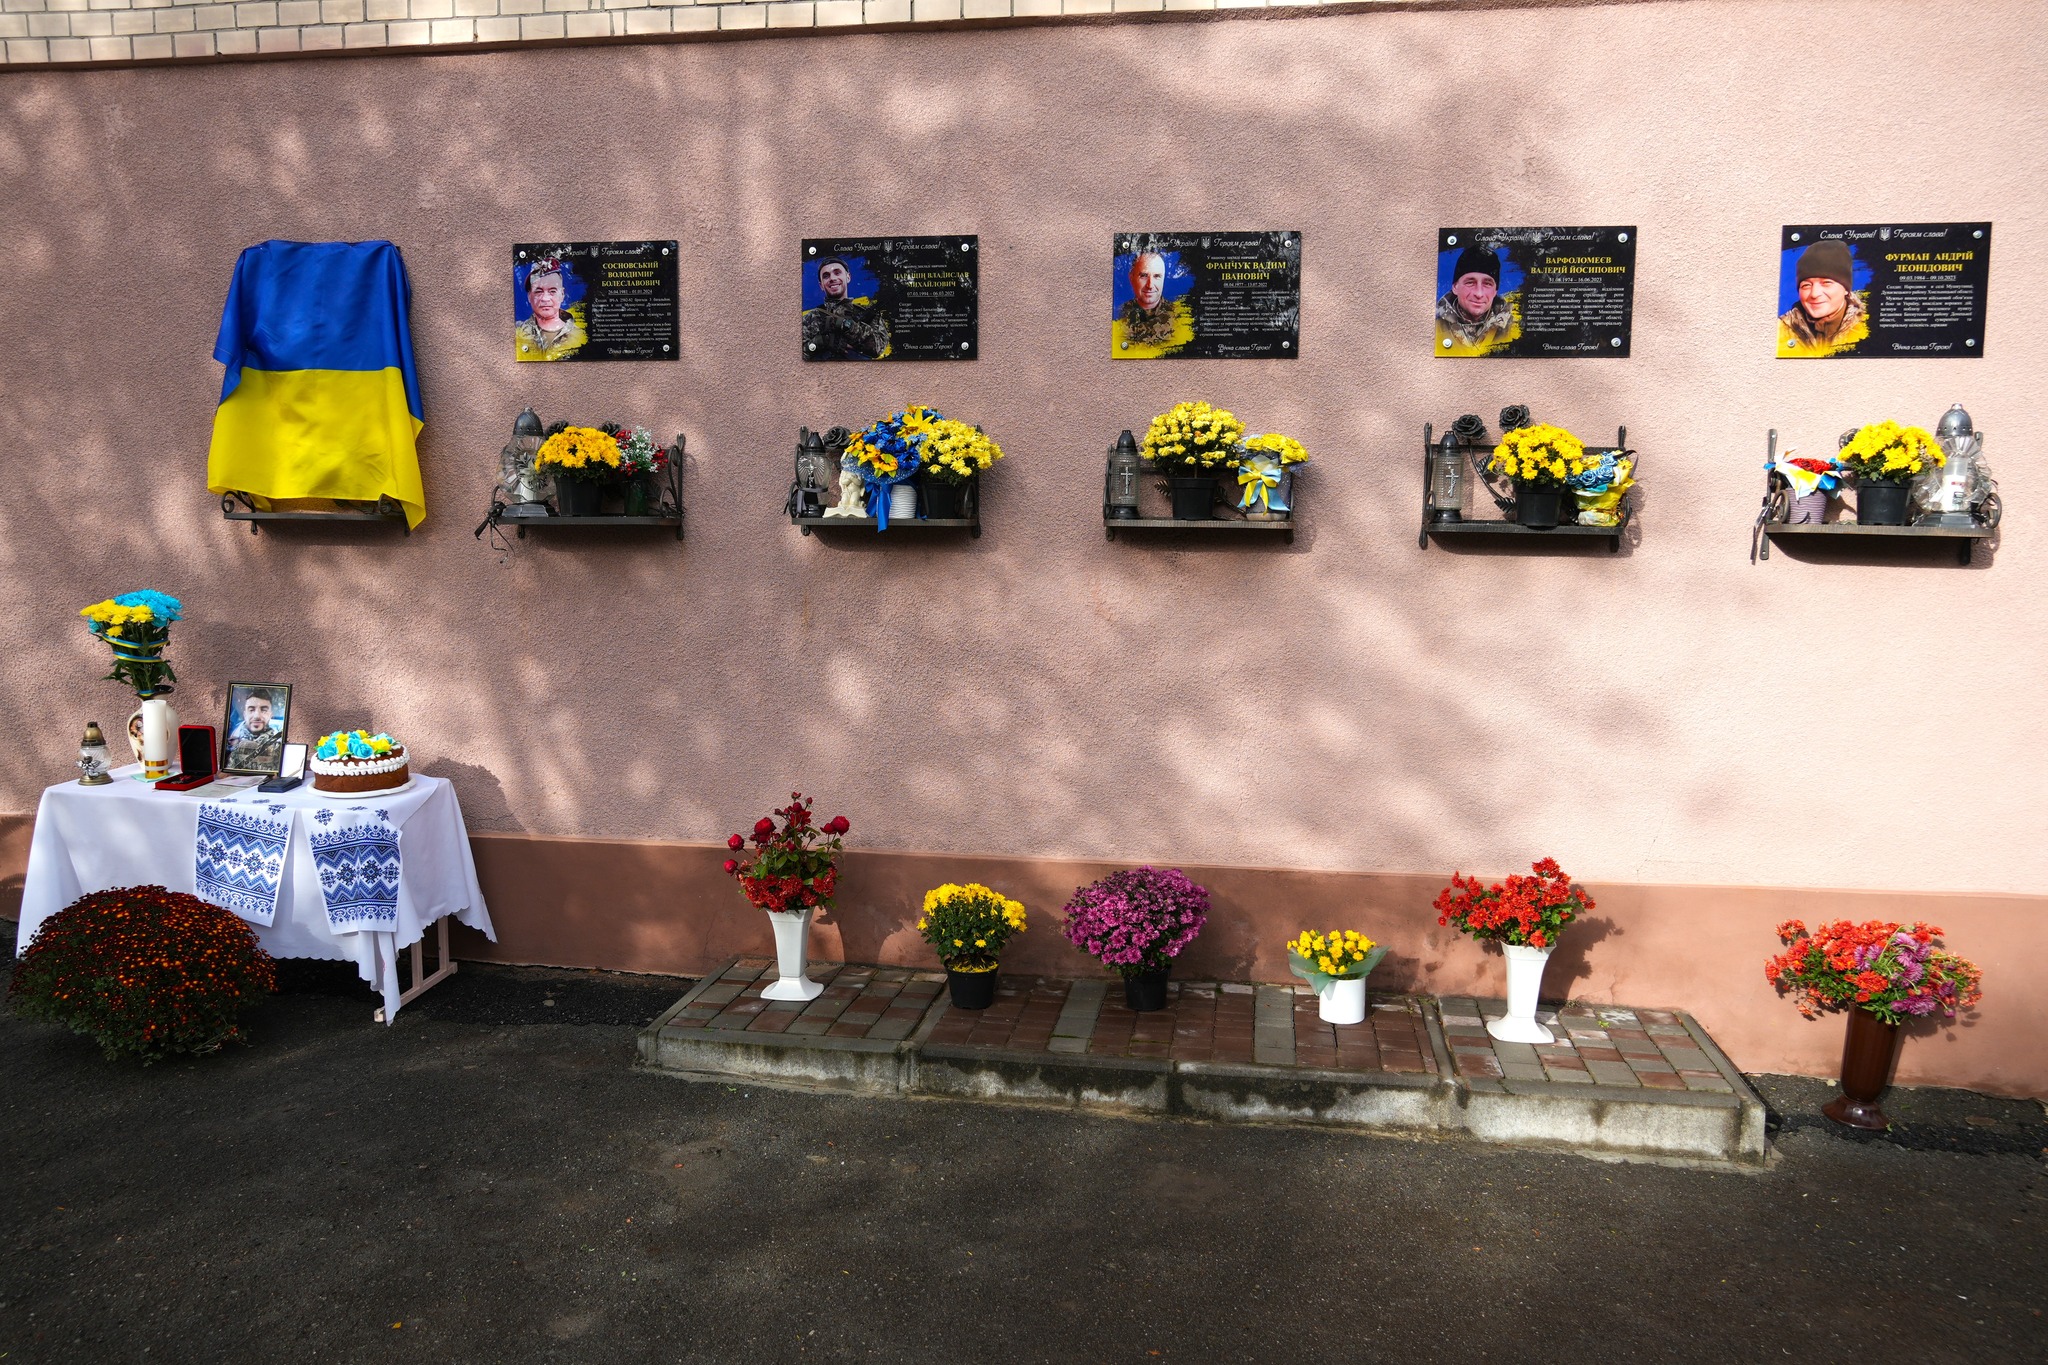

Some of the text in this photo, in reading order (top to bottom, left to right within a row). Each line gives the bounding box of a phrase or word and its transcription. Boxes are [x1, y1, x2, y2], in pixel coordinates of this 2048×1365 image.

[1475, 233, 1497, 242] Слава
[1544, 233, 1571, 242] Героям
[1572, 232, 1595, 241] слава!
[1820, 228, 1948, 240] Слава Україні! Героям слава!
[834, 242, 941, 251] Слава Україні! Героям слава!
[1170, 238, 1199, 247] Україні!
[1214, 238, 1239, 247] Героям
[601, 247, 624, 256] Героям
[1885, 251, 1974, 261] ФУРМАН АНДРІЙ
[602, 261, 658, 269] СОСНОВСЬКИЙ
[1253, 261, 1286, 269] ВАДИМ
[1894, 264, 1963, 272] ЛЕОНІДОВИЧ
[1530, 266, 1626, 274] ВАЛЕРІЙ ЙОСИПОВИЧ
[903, 342, 918, 350] Вічна
[934, 342, 954, 350] Герою!
[1218, 343, 1232, 351] Вічна
[1250, 343, 1271, 351] Герою!
[1542, 343, 1558, 352] Вічна
[1576, 343, 1599, 352] Герою!
[1892, 342, 1909, 352] Вічна
[1929, 342, 1952, 352] Герою!
